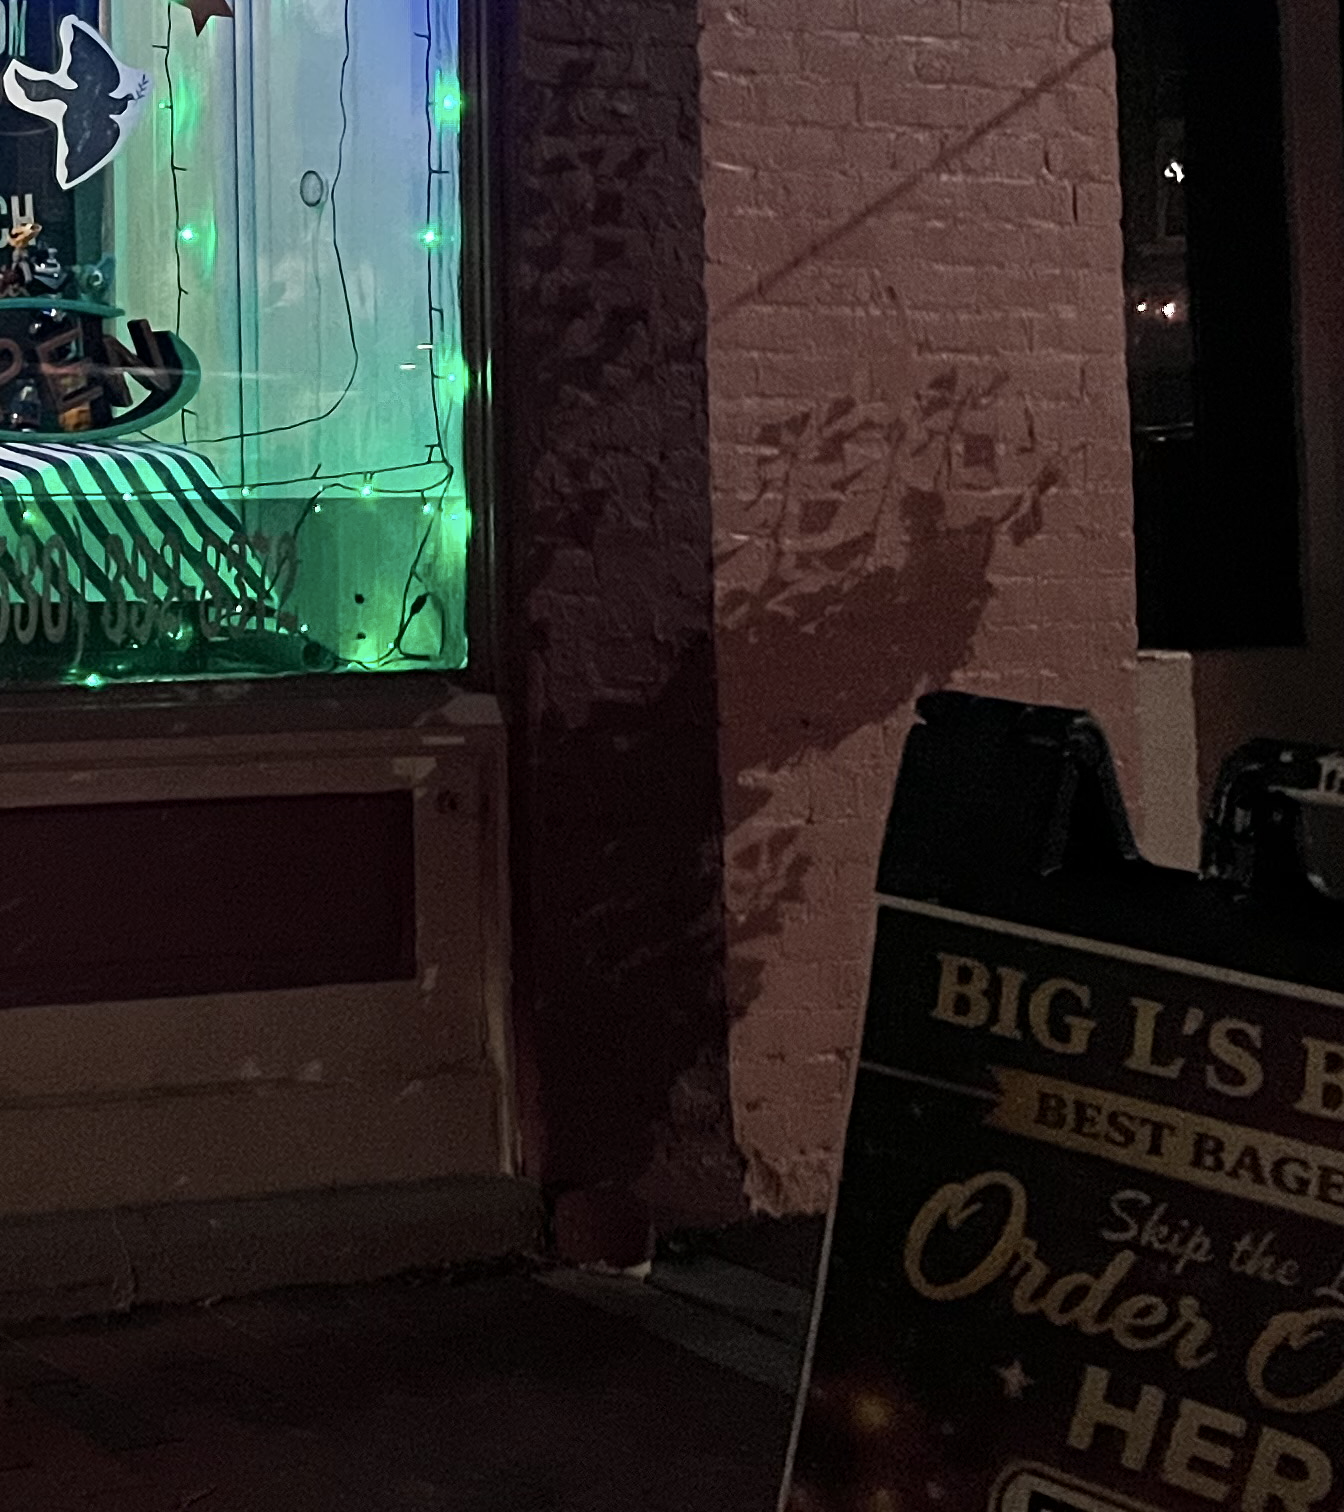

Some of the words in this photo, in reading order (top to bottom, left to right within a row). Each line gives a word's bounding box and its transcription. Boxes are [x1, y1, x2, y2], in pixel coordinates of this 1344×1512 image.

[931, 949, 1097, 1058] BIG
[1123, 996, 1265, 1098] L'S
[1034, 1089, 1176, 1157] BEST
[903, 1170, 1217, 1369] Order
[1101, 1188, 1212, 1275] Skip
[1229, 1225, 1300, 1287] the
[1065, 1364, 1334, 1512] HER
